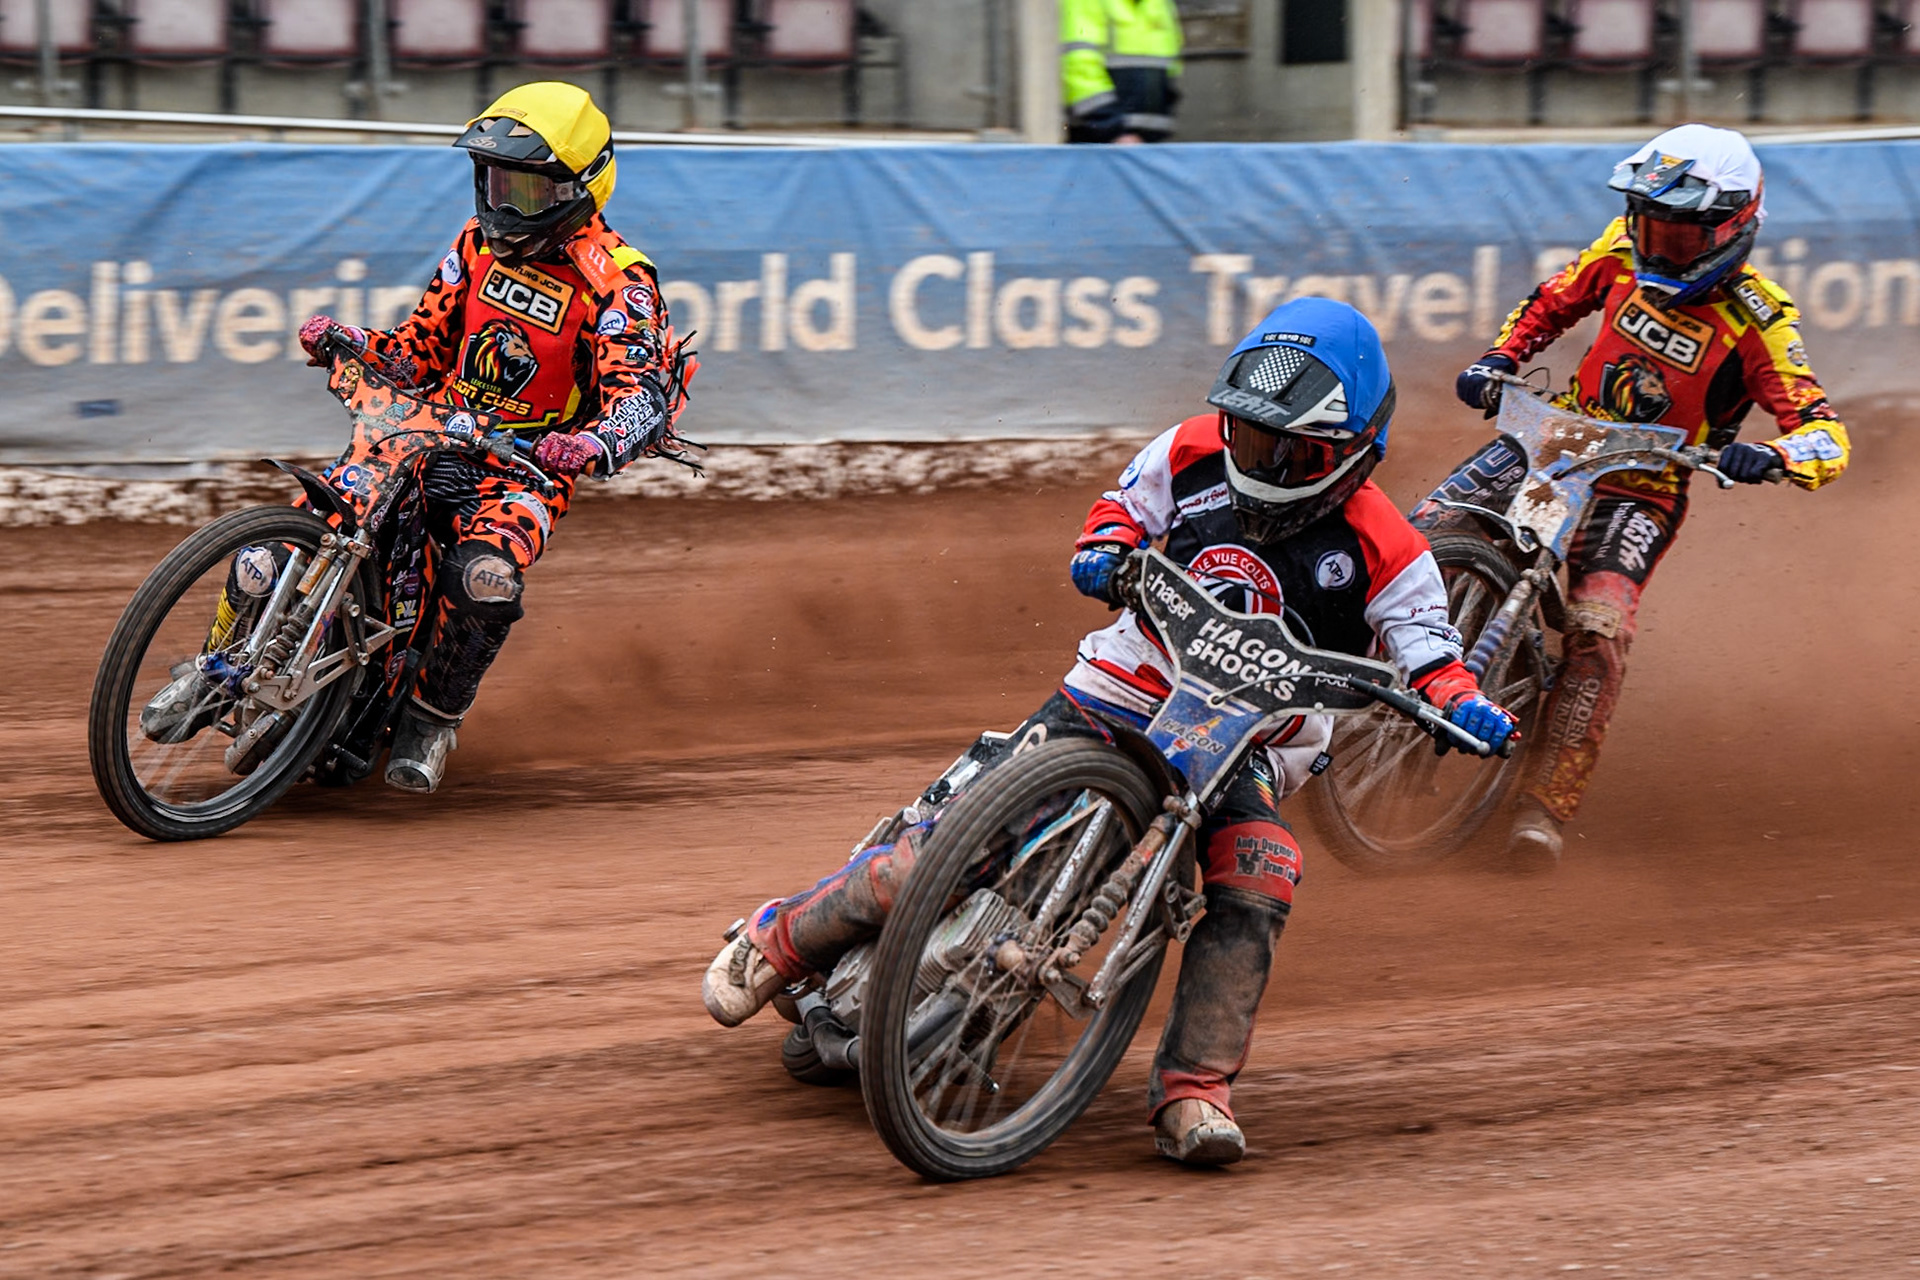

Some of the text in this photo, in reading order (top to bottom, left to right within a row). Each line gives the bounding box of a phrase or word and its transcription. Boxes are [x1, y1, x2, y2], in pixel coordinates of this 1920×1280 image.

[486, 278, 559, 323] JCB
[539, 278, 563, 294] JCB
[1738, 286, 1774, 322] JCB
[0, 259, 422, 366] eliverin
[660, 252, 856, 352] orld
[888, 252, 1163, 350] Class
[1619, 312, 1698, 364] JCB
[470, 378, 502, 393] LEICESTER
[481, 392, 531, 415] CUBS
[1214, 389, 1291, 417] LEATT
[472, 569, 508, 592] ATPI
[1212, 553, 1238, 564] VUE
[1240, 557, 1271, 590] COLTS
[1326, 560, 1345, 582] ATPI
[1197, 617, 1311, 682] HAGON
[1186, 637, 1297, 702] SHOCKS
[1160, 718, 1227, 755] HAGON
[1236, 836, 1259, 851] Andy
